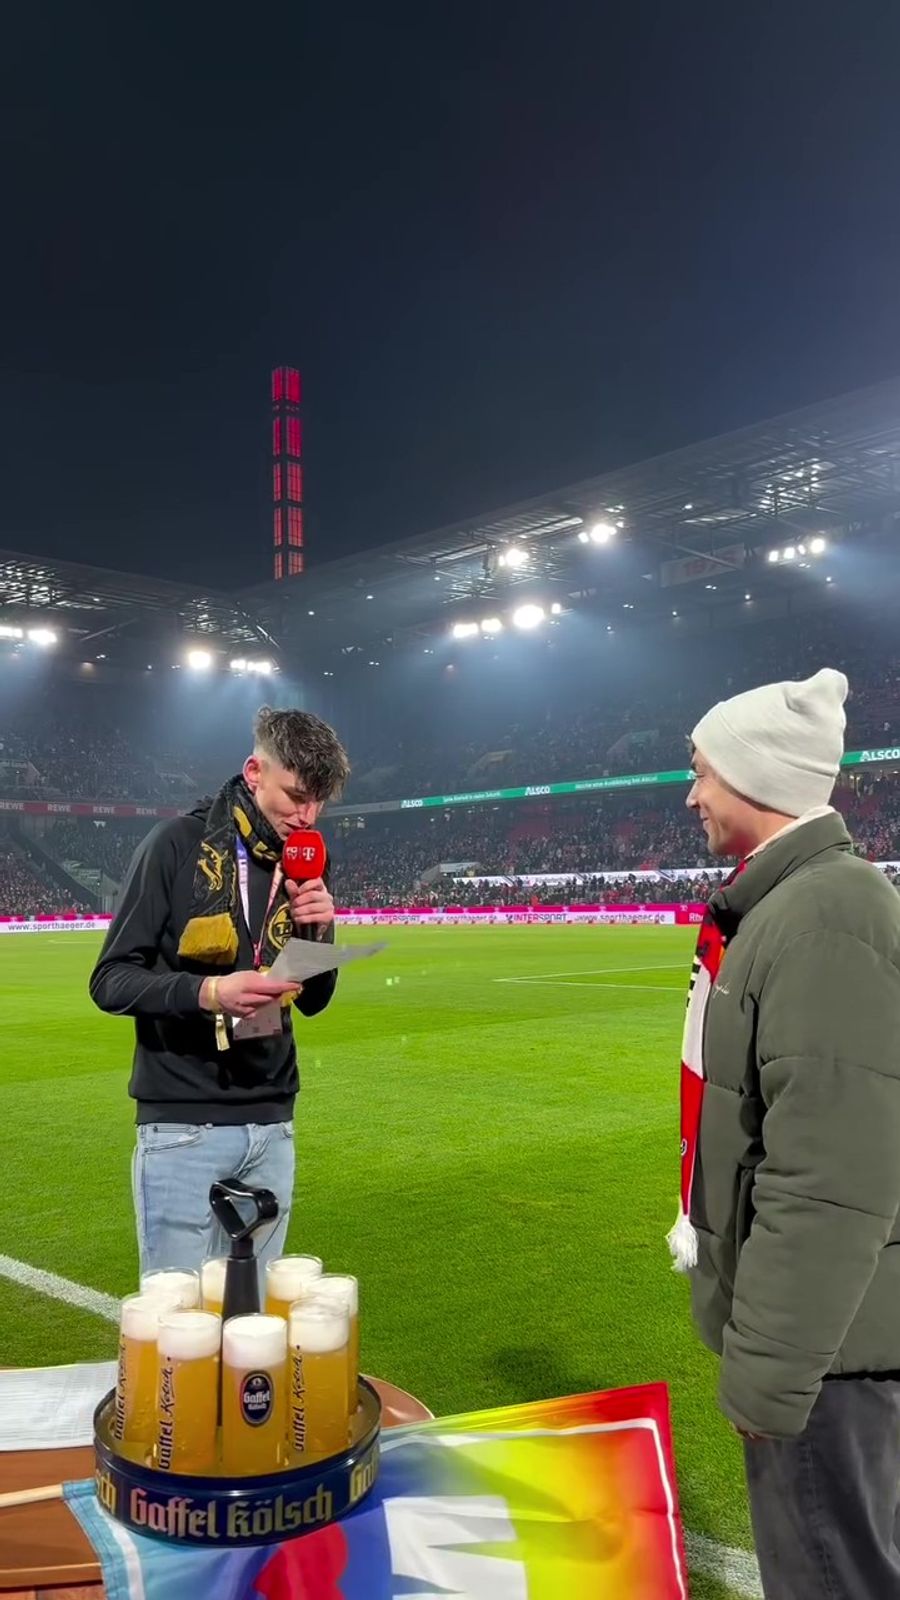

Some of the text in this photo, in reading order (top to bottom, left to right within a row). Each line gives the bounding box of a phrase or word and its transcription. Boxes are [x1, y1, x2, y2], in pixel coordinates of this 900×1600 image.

[525, 785, 550, 796] ALSCO
[47, 803, 71, 812] REWE
[401, 800, 423, 809] ALSCO
[93, 805, 116, 815] REWE
[136, 807, 158, 816] REWE
[513, 913, 567, 922] INTERSPORT
[244, 1388, 270, 1404] Gaffel
[130, 1482, 333, 1539] Gaffel Kölsch
